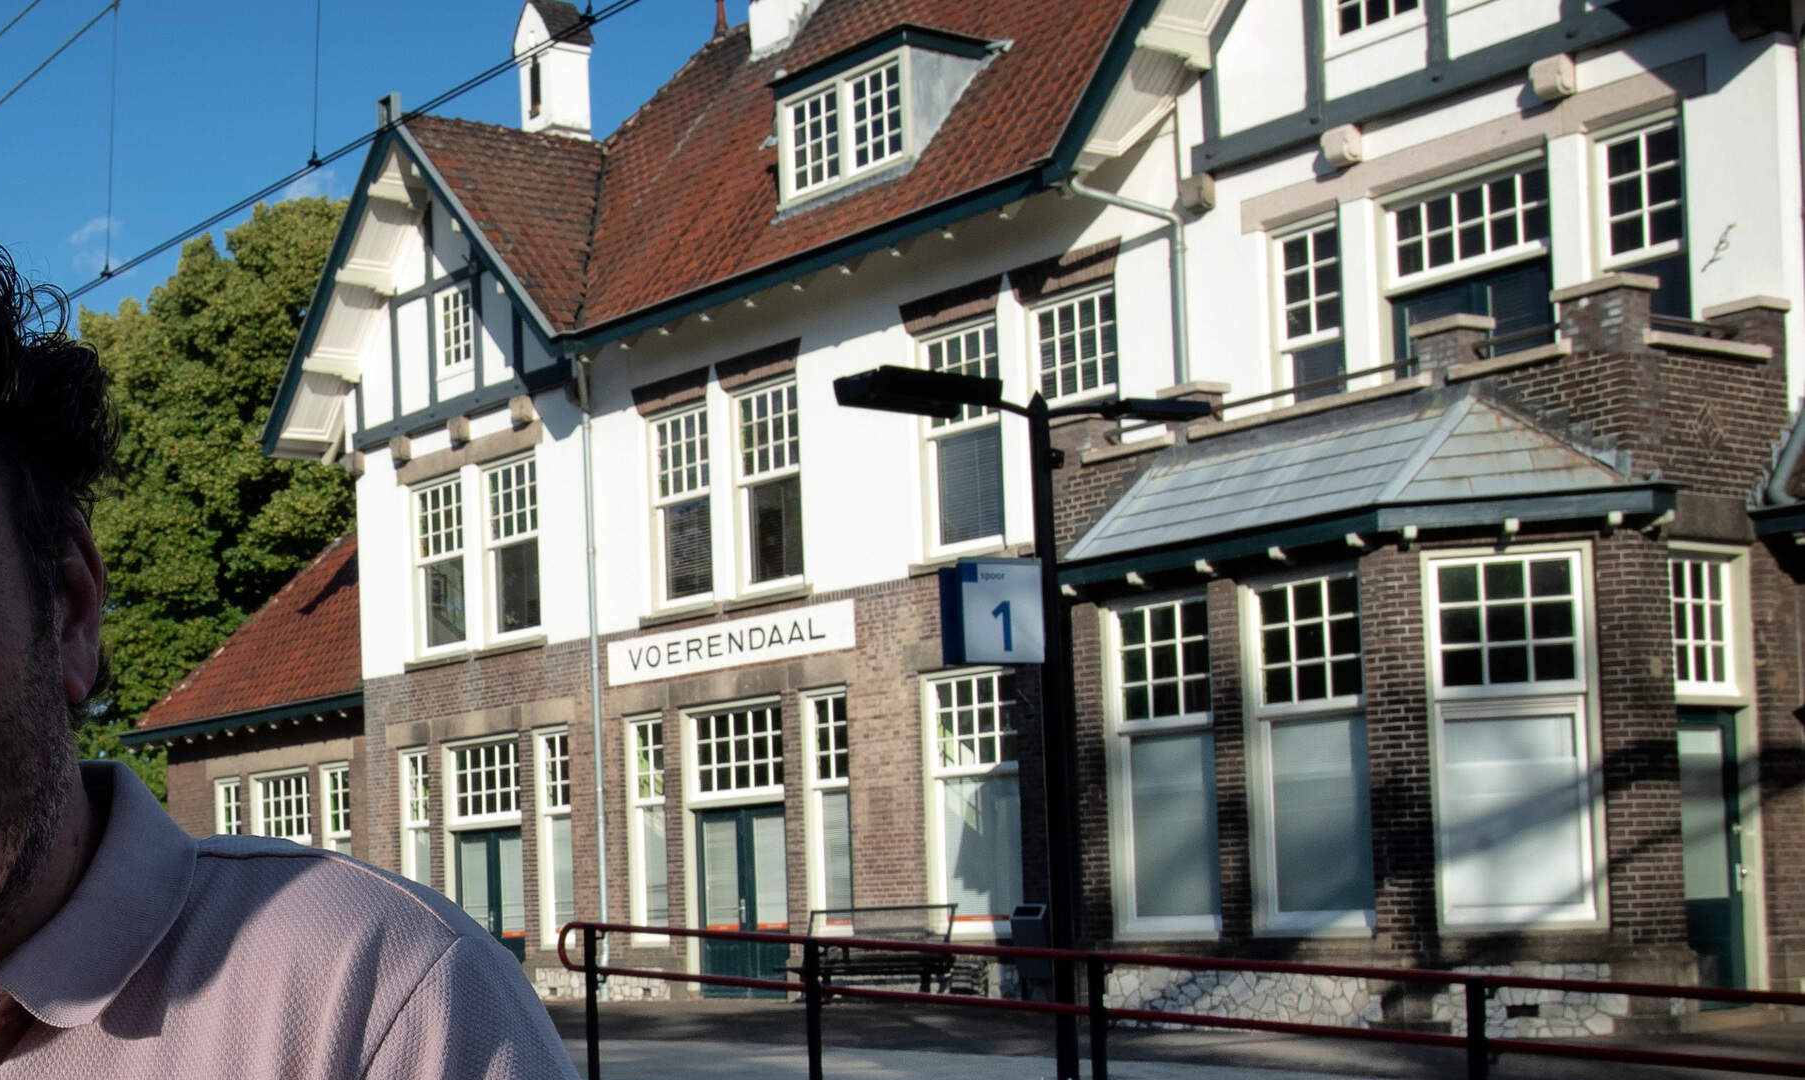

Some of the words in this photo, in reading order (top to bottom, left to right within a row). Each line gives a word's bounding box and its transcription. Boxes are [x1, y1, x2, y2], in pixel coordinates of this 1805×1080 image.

[980, 571, 1006, 582] spoor
[628, 617, 826, 671] VOERENDAAL
[991, 600, 1013, 652] 1
